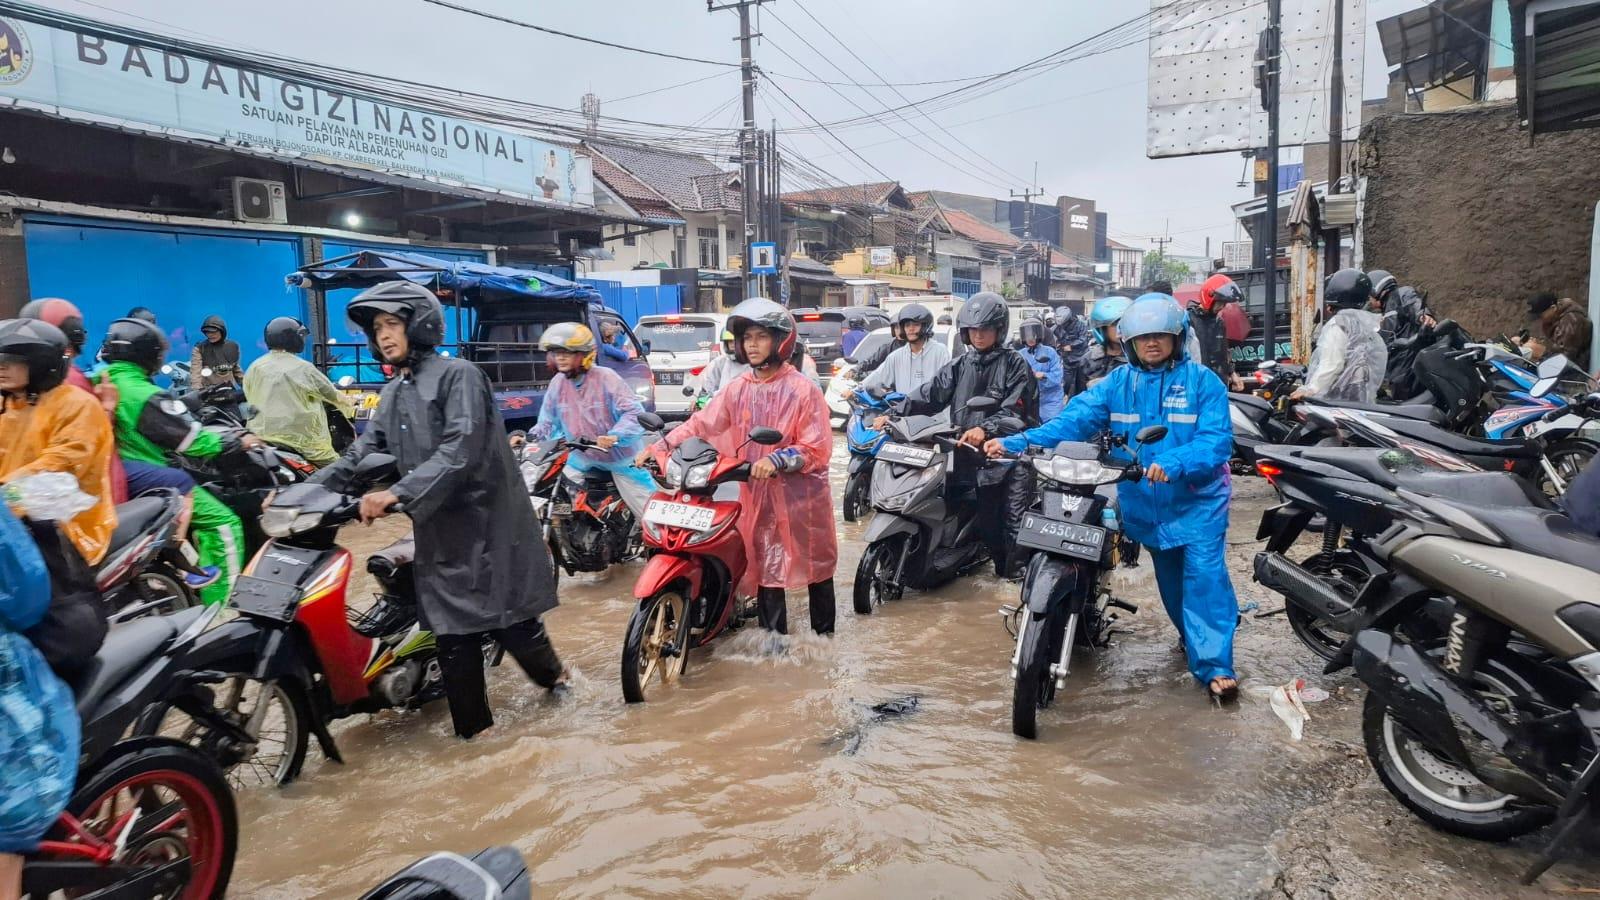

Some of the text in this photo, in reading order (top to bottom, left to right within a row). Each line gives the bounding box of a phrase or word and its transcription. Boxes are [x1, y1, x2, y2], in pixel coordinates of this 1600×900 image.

[76, 33, 523, 163] BADAN GIZI NASIONAL
[237, 131, 274, 145] TERUSAN
[276, 139, 331, 156] BOJONGSOANG
[241, 104, 448, 159] SATUAN PELAYANAN PEMENUHAN GIZI
[305, 130, 405, 160] DAPUR ALBARACK
[650, 501, 657, 510] D
[1025, 517, 1034, 529] D
[1447, 612, 1467, 674] NMAX
